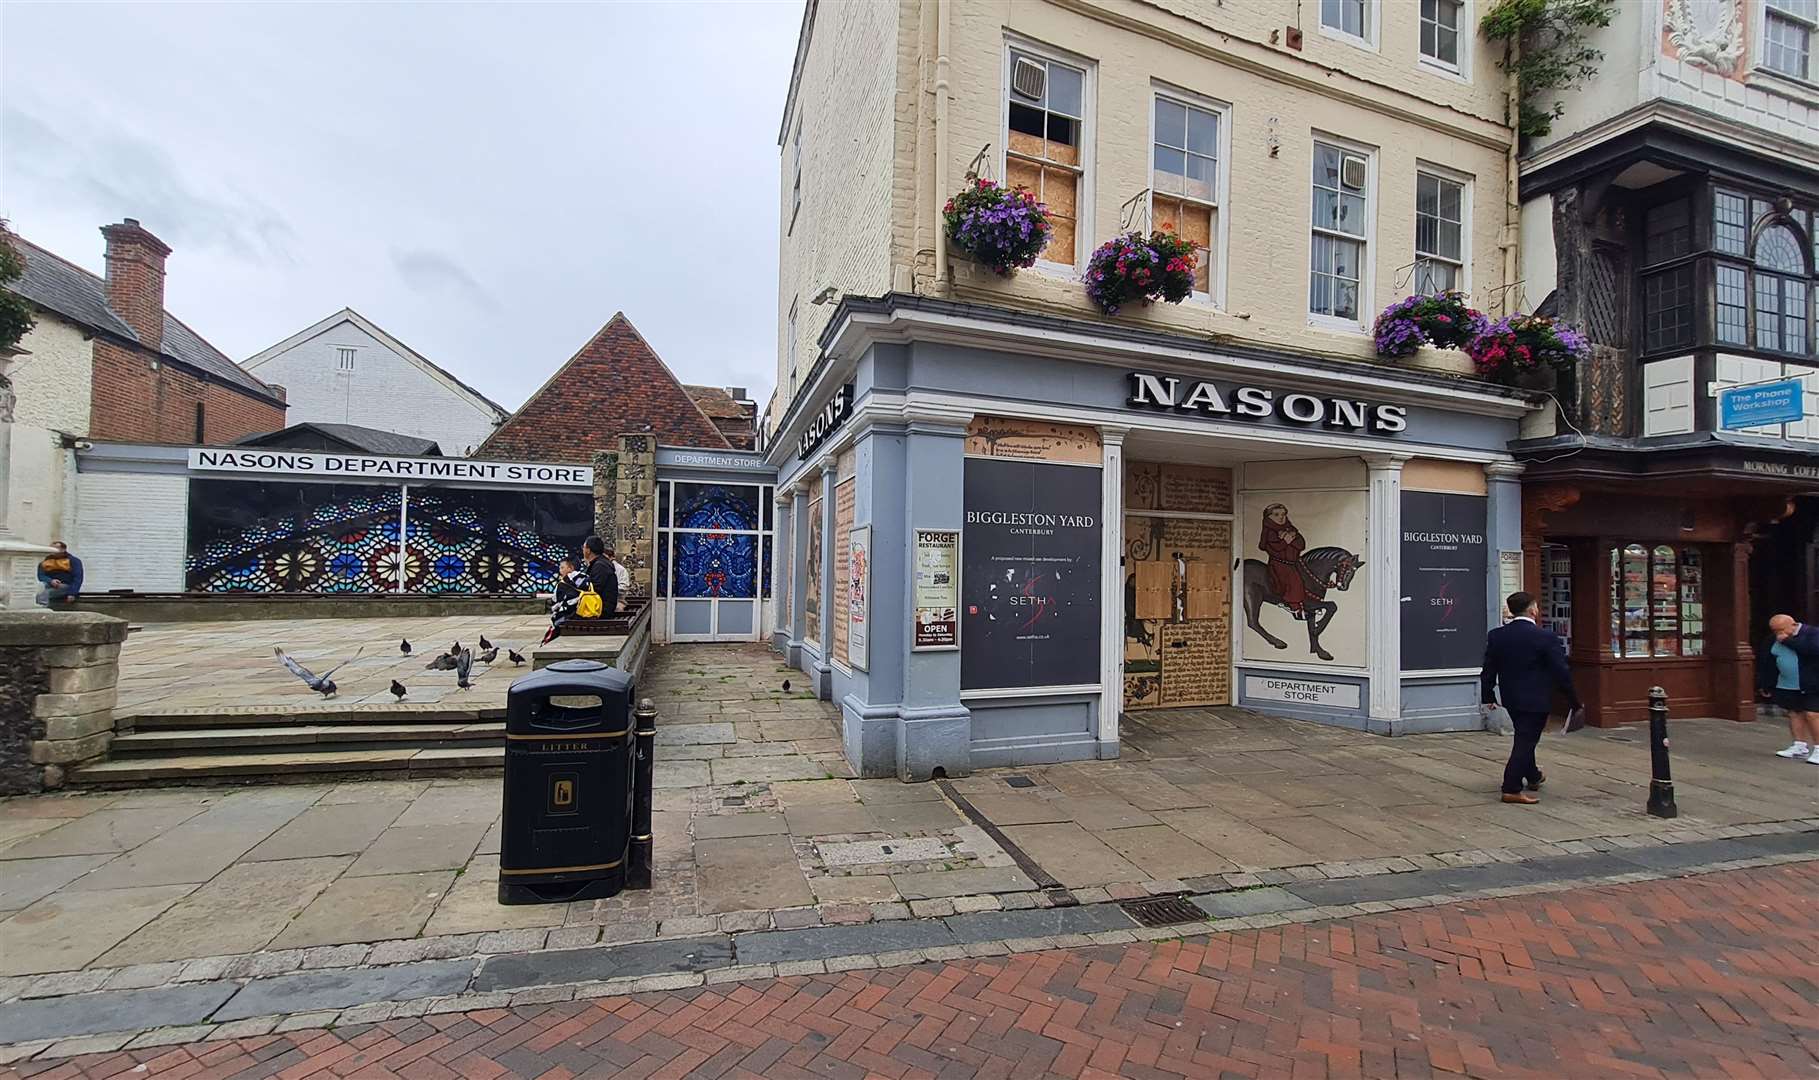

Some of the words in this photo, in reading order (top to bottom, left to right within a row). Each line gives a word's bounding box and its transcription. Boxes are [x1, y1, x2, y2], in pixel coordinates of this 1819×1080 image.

[1731, 394, 1751, 403] The
[1754, 388, 1792, 399] Phone
[1131, 373, 1408, 433] NASONS
[1732, 398, 1790, 411] Workshop
[199, 451, 315, 471] NASONS
[324, 456, 501, 479] DEPARTMENT
[506, 465, 586, 483] STORE
[674, 454, 733, 466] DEPARTMENT
[733, 457, 762, 468] STORE
[1743, 461, 1788, 474] MORNING
[967, 511, 1056, 526] BIGGLESTON
[1059, 515, 1094, 528] YARD
[918, 532, 955, 543] FORGE
[1403, 532, 1459, 544] BIGGLESTON
[1460, 534, 1483, 544] YARD
[924, 625, 947, 633] OPEN
[1267, 680, 1336, 694] DEPARTMENT
[1284, 691, 1319, 702] STORE
[542, 743, 588, 751] LITTER
